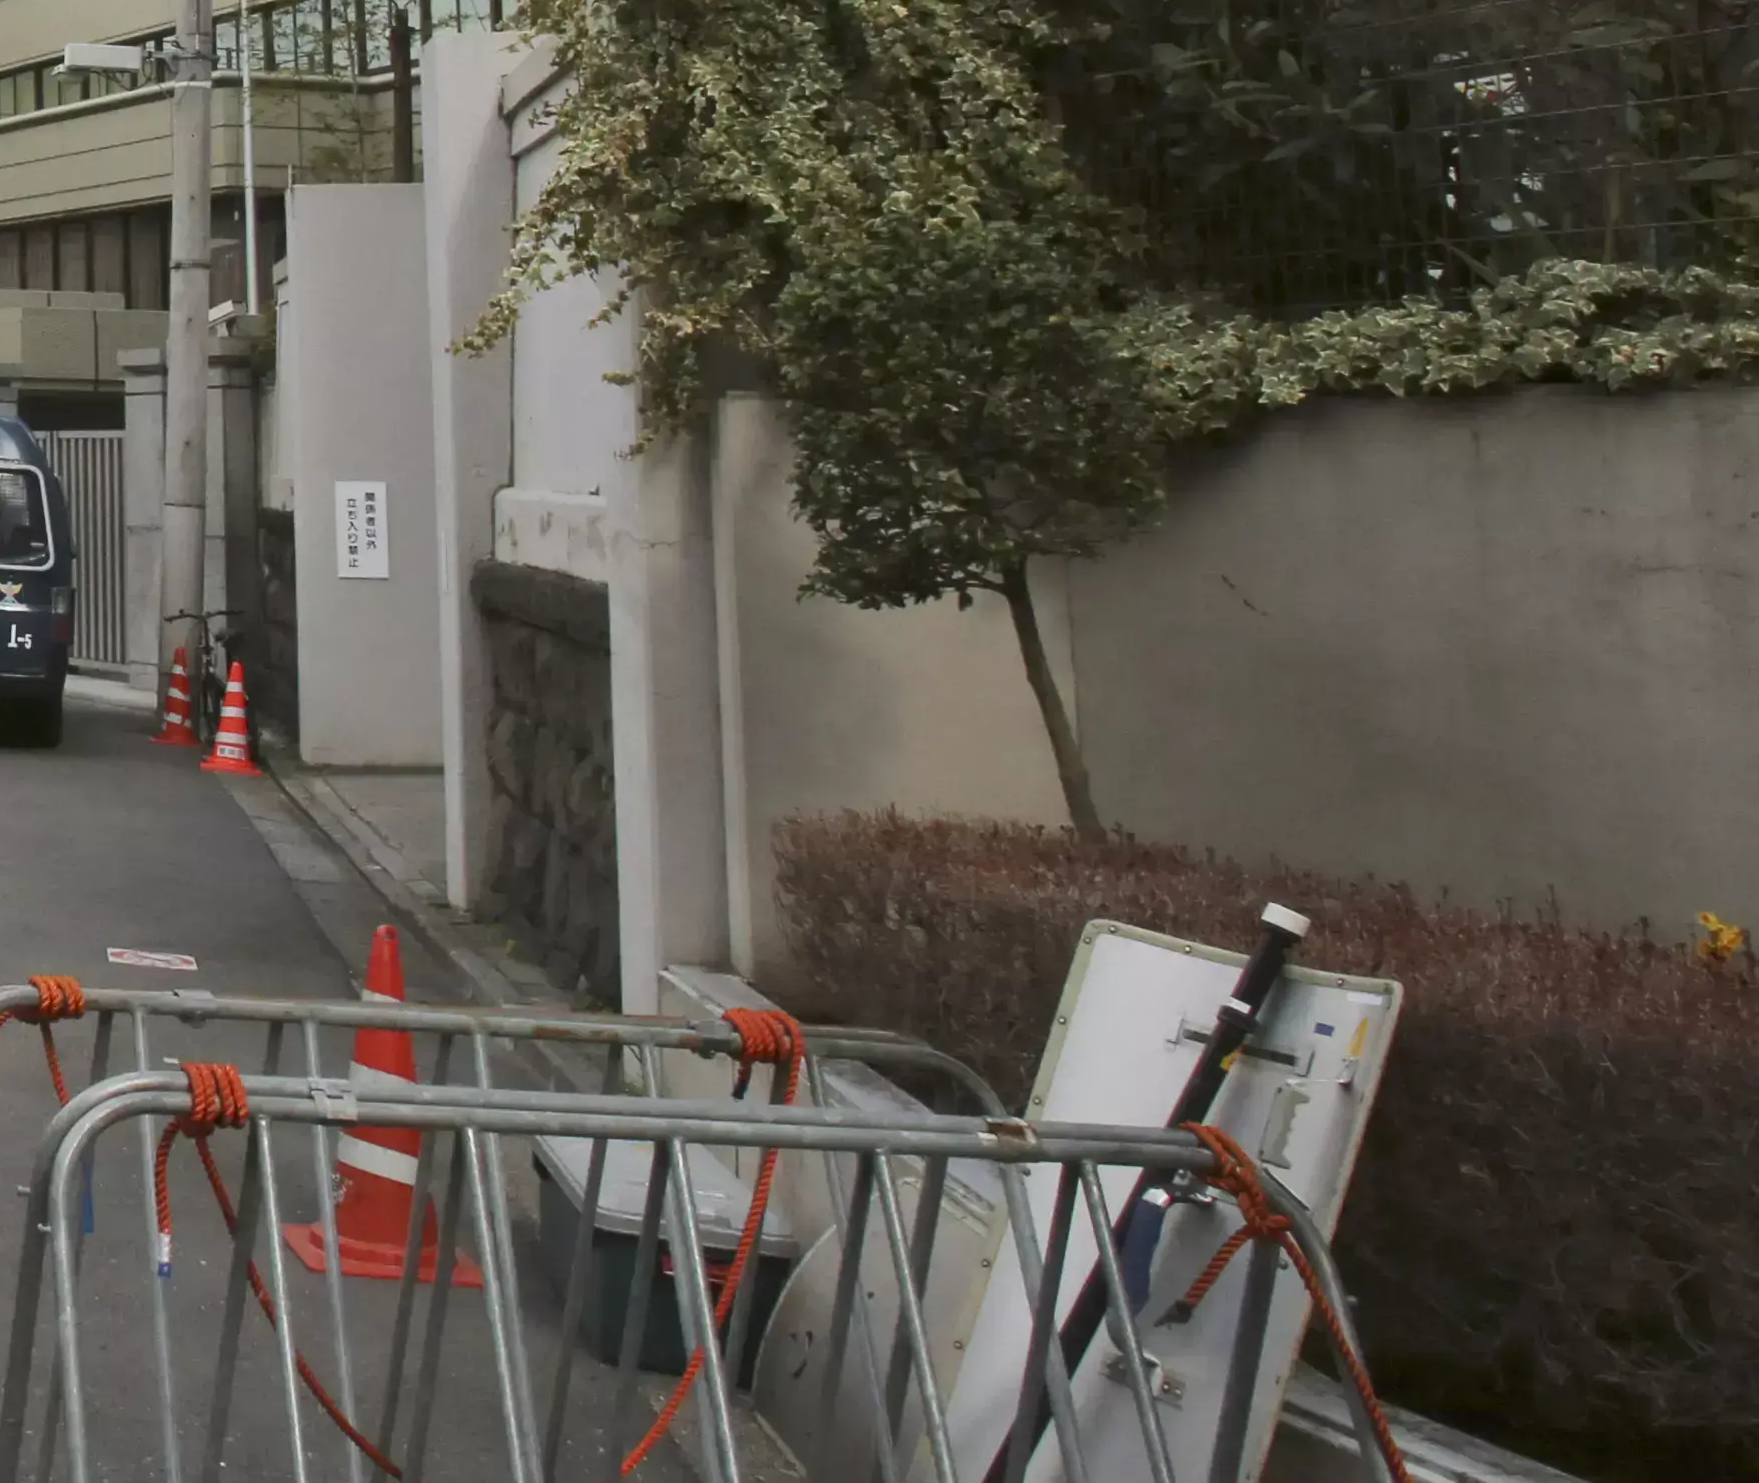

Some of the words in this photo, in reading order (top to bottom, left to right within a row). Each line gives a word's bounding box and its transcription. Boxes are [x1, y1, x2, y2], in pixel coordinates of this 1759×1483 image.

[346, 497, 360, 568] 立ち入り禁止
[364, 491, 377, 550] 関係者以外
